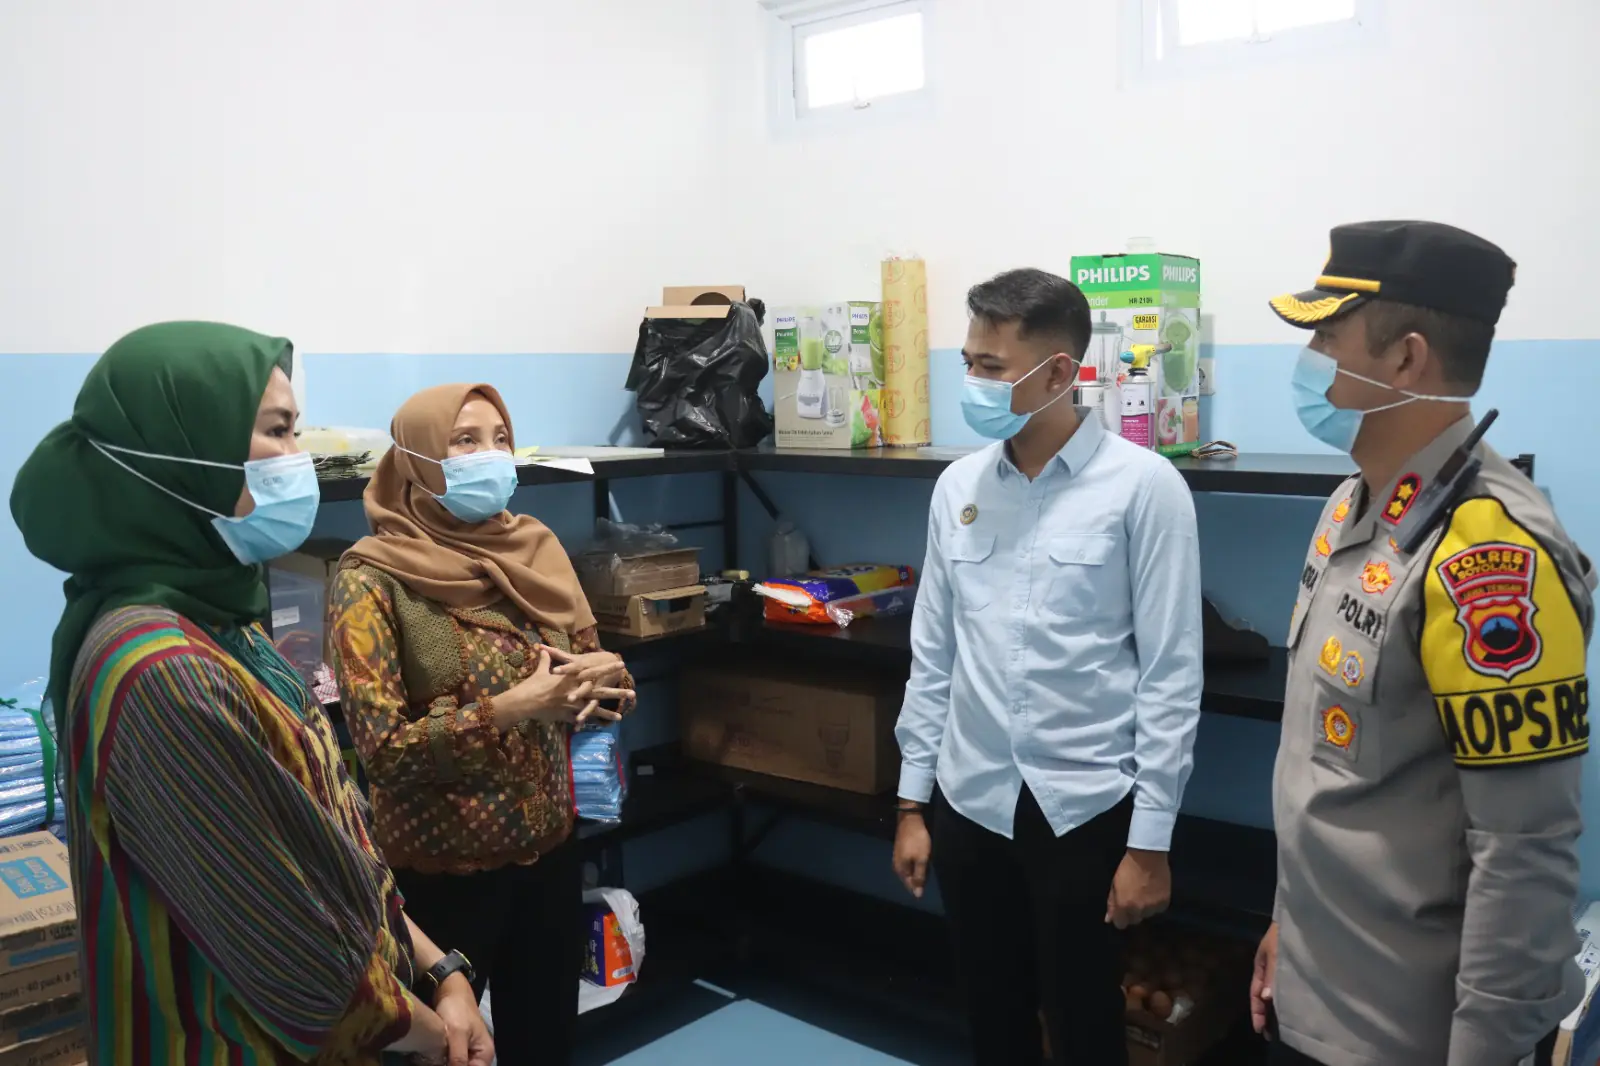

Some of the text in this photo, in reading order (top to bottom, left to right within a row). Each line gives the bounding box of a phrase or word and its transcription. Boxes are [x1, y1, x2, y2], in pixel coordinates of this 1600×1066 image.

[1077, 264, 1151, 285] PHILIPS
[1162, 265, 1197, 283] PHILIPS
[1135, 315, 1157, 324] GARANSI
[1448, 550, 1524, 576] POLRES
[1336, 592, 1382, 640] POLRI
